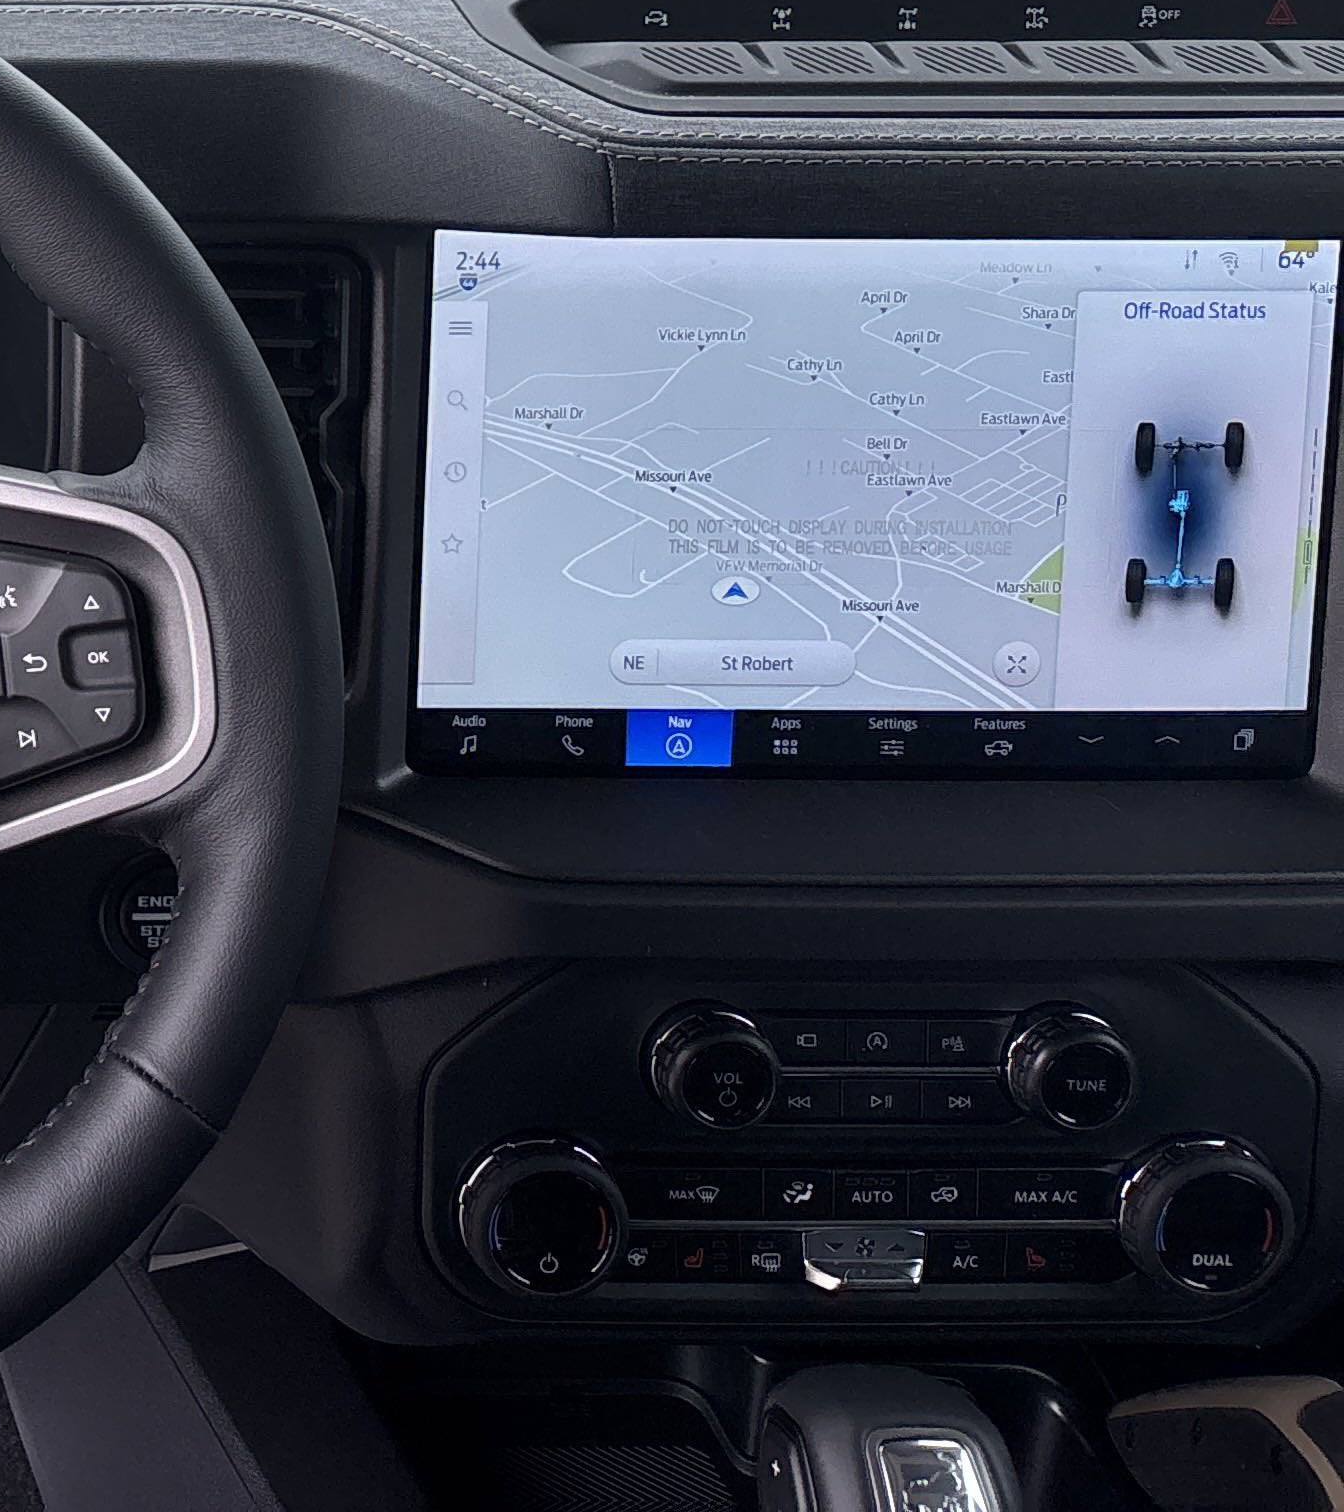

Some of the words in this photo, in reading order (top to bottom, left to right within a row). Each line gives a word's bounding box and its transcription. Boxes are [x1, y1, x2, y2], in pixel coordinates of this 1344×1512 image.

[1158, 9, 1182, 21] OFF
[456, 251, 501, 271] 2:44
[980, 262, 1033, 274] Meadow
[1036, 262, 1052, 273] Ln
[861, 291, 891, 305] April
[893, 291, 908, 303] Dr
[1022, 306, 1059, 319] Shara
[1061, 306, 1076, 319] Dr
[1124, 301, 1204, 320] Off-Road
[1208, 301, 1266, 320] Status
[658, 329, 695, 341] Vickie
[697, 329, 728, 343] Lynn
[730, 329, 746, 341] Ln
[894, 331, 924, 345] April
[926, 331, 941, 343] Dr
[787, 359, 824, 372] Cathy
[826, 359, 842, 371] Ln
[869, 393, 907, 407] Cathy
[909, 393, 925, 405] Ln
[514, 407, 566, 419] Marshall
[568, 407, 584, 419] Dr
[981, 412, 1040, 425] Eastlawn
[1042, 412, 1066, 425] Ave
[867, 438, 889, 450] Bell
[891, 438, 908, 450] Dr
[635, 470, 686, 482] Missouri
[688, 470, 712, 482] Ave
[867, 474, 926, 486] Eastlawn
[928, 474, 952, 486] Ave
[668, 519, 689, 535] DO
[696, 519, 724, 535] NOT
[734, 519, 780, 535] TOUCH
[789, 519, 846, 535] DISPLAY
[855, 519, 907, 535] DURING
[915, 519, 1012, 535] INSTALLATION
[668, 540, 699, 555] THIS
[707, 540, 739, 555] FILM
[746, 540, 761, 555] IS
[767, 540, 787, 555] TO
[796, 540, 815, 555] BE
[823, 540, 891, 555] REMOVED
[900, 540, 957, 555] BEFORE
[964, 540, 1012, 555] USAGE
[716, 560, 746, 572] VFW
[748, 560, 806, 572] Memorial
[809, 560, 823, 572] Dr
[996, 581, 1048, 594] Marshall
[842, 600, 893, 612] Missouri
[895, 600, 919, 612] Ave
[87, 651, 110, 664] OK
[623, 656, 645, 670] NE
[721, 656, 738, 671] St
[741, 656, 794, 671] Robert
[452, 715, 486, 728] Audio
[556, 715, 593, 728] Phone
[668, 716, 692, 728] Nav
[771, 717, 802, 732] Apps
[868, 717, 918, 732] Settings
[974, 717, 1026, 731] Features
[713, 1072, 743, 1085] VOL
[1066, 1079, 1107, 1092] TUNE
[669, 1189, 695, 1201] MAX
[852, 1190, 893, 1204] AUTO
[1014, 1190, 1048, 1204] MAX
[1052, 1190, 1078, 1204] A/C
[751, 1255, 761, 1267] R
[952, 1254, 979, 1269] A/C
[1192, 1254, 1233, 1268] DUAL
